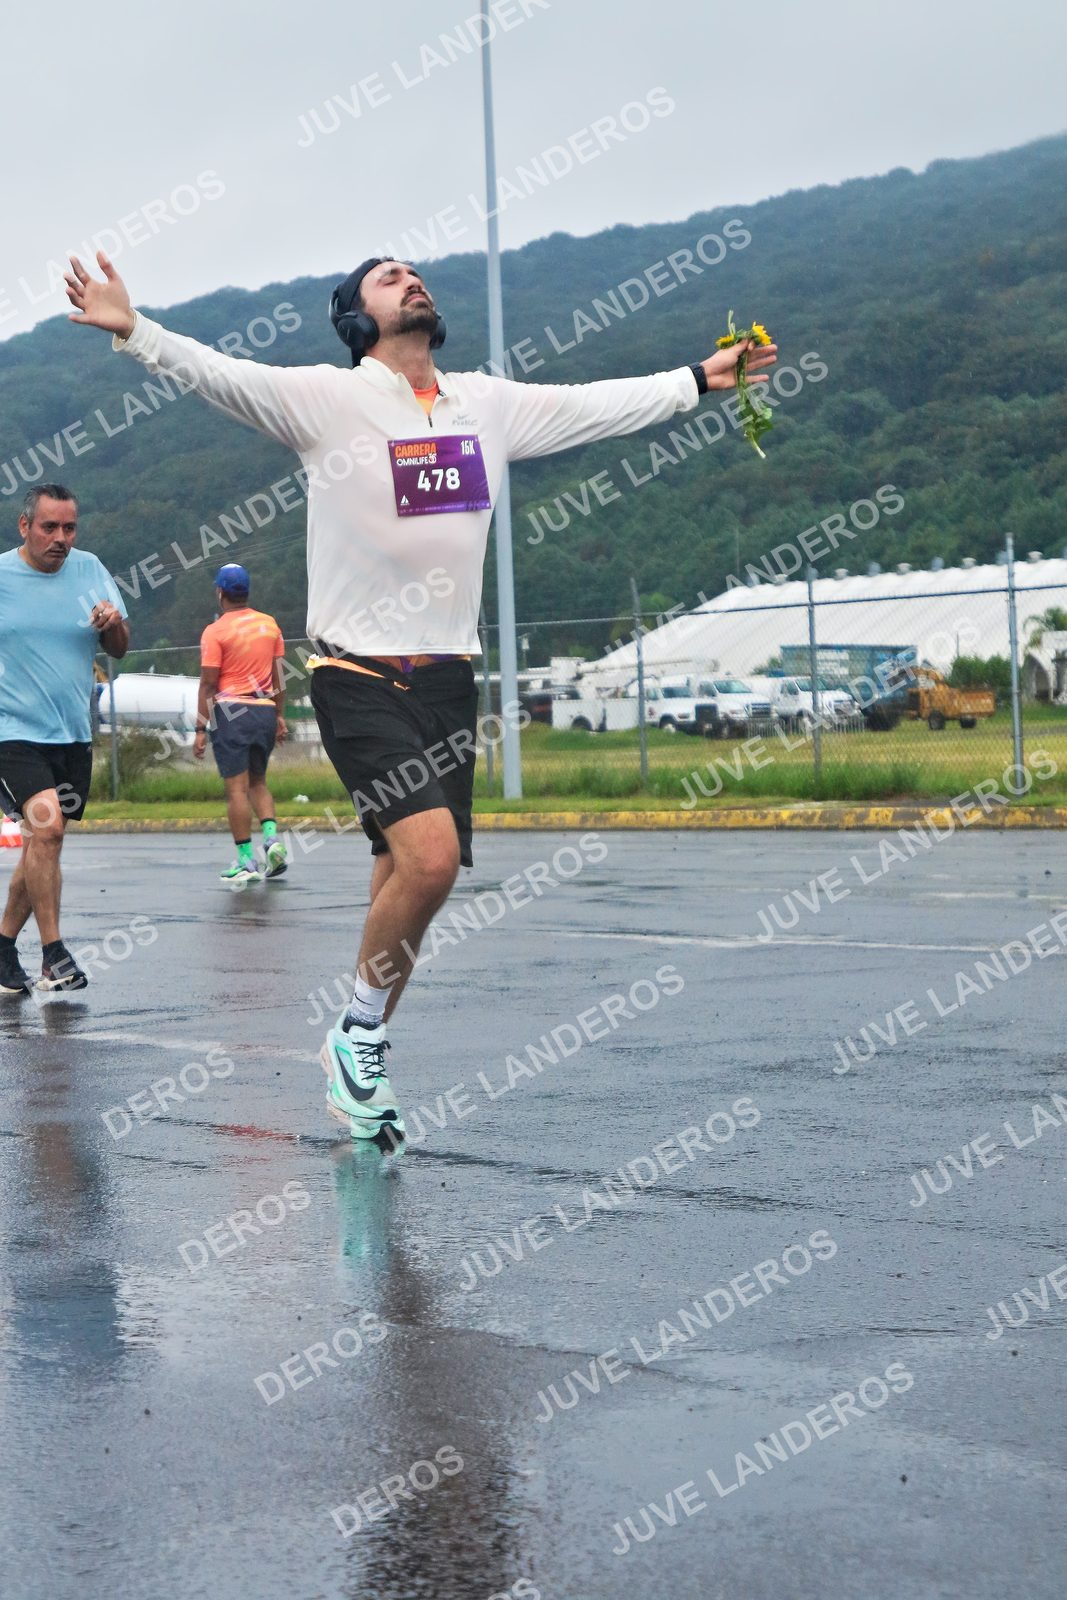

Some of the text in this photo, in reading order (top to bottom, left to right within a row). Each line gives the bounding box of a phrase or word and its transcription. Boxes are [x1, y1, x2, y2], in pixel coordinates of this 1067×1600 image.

[394, 442, 438, 458] CARRERA
[461, 440, 476, 455] 15K
[396, 457, 429, 467] OMNILIFE
[417, 467, 461, 492] 478
